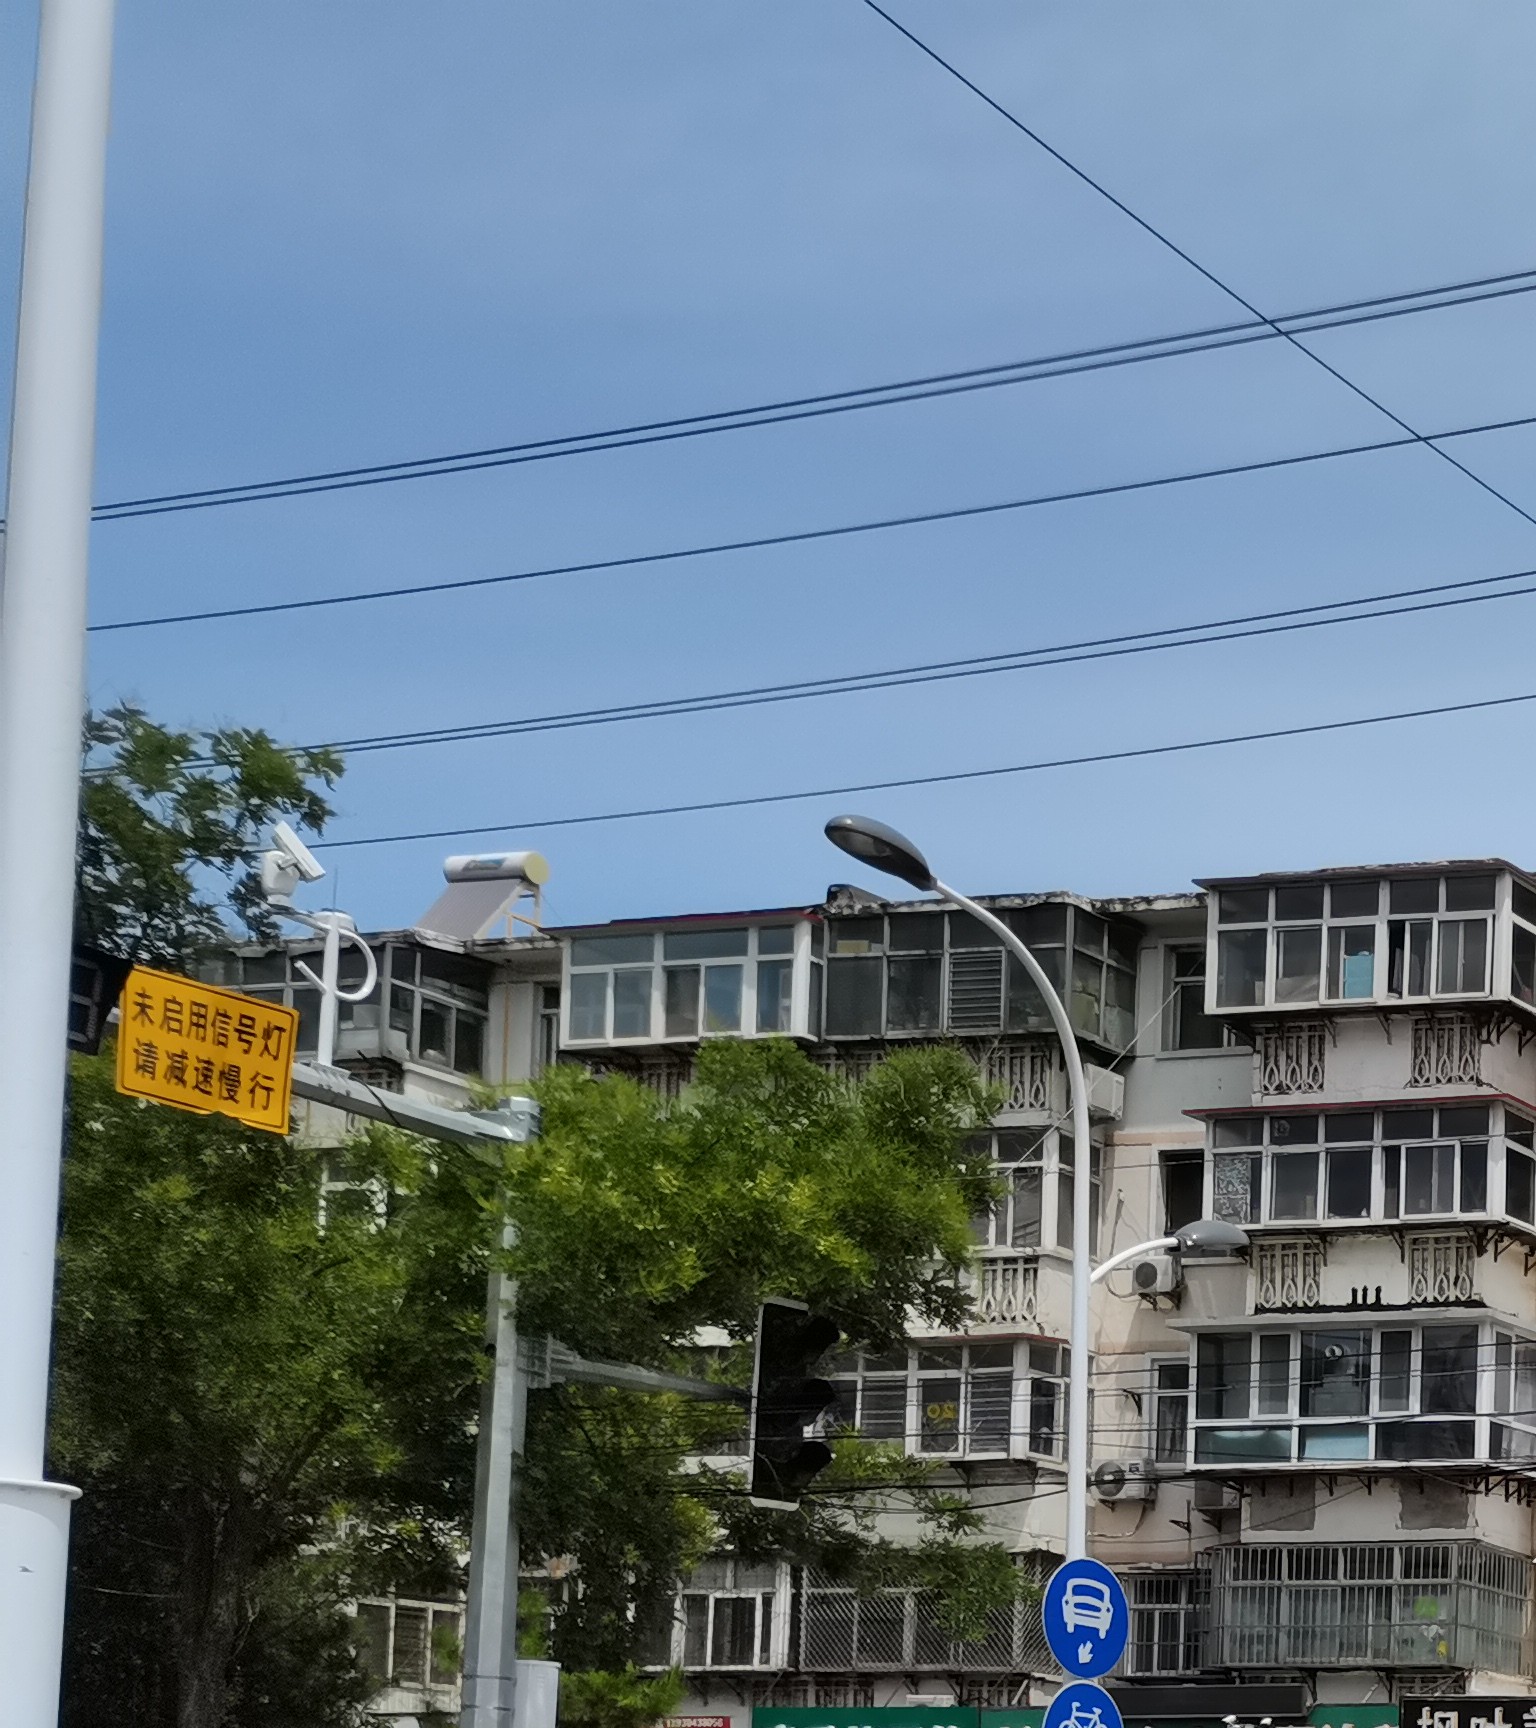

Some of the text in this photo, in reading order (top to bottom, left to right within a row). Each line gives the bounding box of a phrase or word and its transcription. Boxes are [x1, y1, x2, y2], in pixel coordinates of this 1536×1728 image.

[131, 987, 287, 1061] 未启用信号灯
[133, 1038, 275, 1110] 请减速慢行
